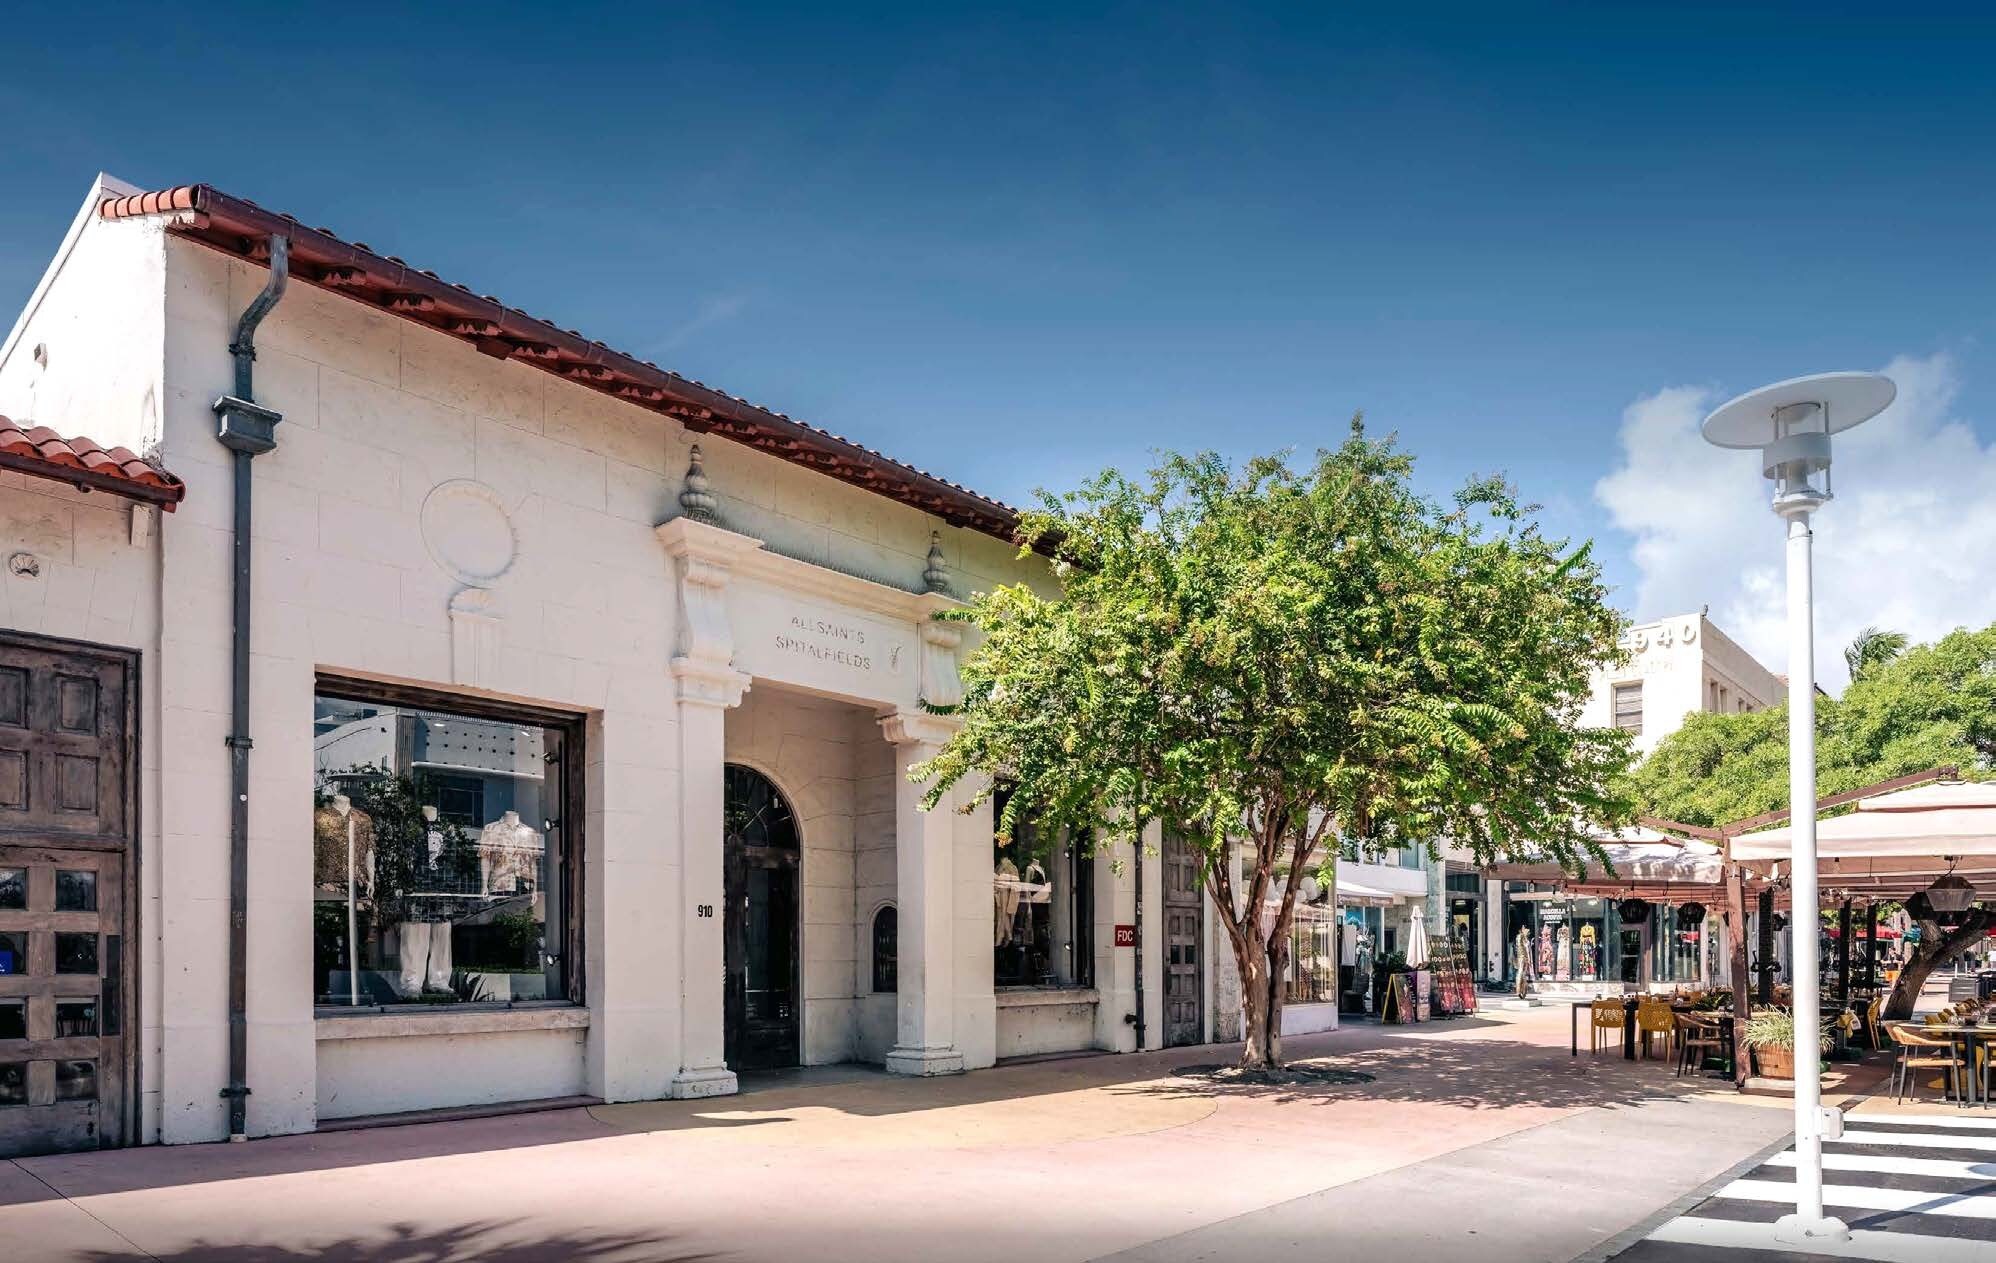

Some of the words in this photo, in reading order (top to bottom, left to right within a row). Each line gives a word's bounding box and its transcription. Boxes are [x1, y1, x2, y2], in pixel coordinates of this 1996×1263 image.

[776, 635, 871, 669] SPITALFIELDS
[697, 904, 713, 918] 910
[1117, 930, 1133, 942] FDC
